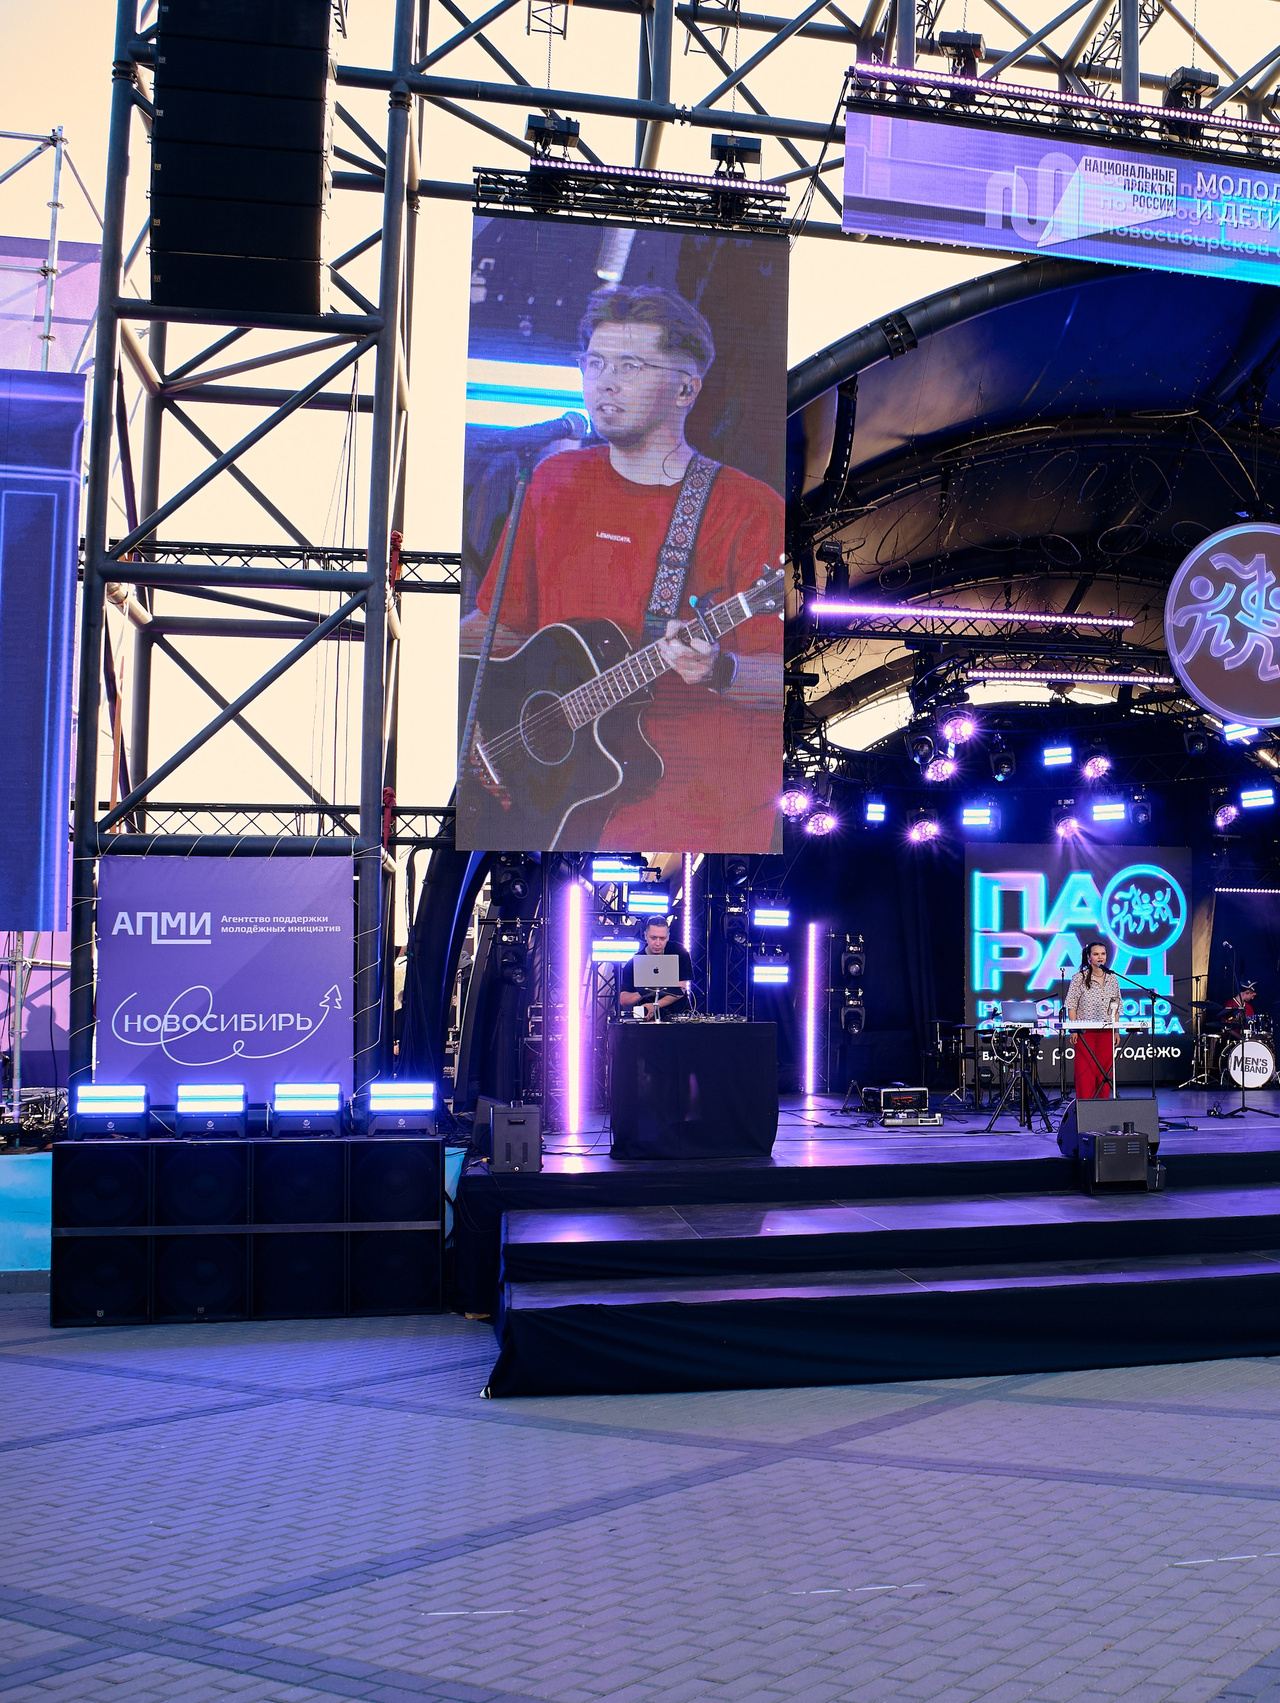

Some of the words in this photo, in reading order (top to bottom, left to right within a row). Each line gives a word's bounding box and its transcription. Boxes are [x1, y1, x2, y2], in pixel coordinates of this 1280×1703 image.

[1084, 158, 1175, 183] НАЦИОНАЛЬНЫЕ
[1123, 178, 1175, 197] ПРОЕКТЫ
[1132, 194, 1174, 212] РОССИИ
[1197, 199, 1212, 220] И
[971, 869, 1106, 934] ПА
[111, 911, 212, 944] АПМИ
[220, 914, 271, 924] Агентство
[272, 914, 329, 925] поддержки
[220, 923, 286, 934] молодёжных
[287, 924, 341, 934] инициатив
[124, 1013, 313, 1033] НОВОСИБИРЬ
[1233, 1055, 1268, 1071] MEN'S
[1244, 1065, 1268, 1074] BAND
